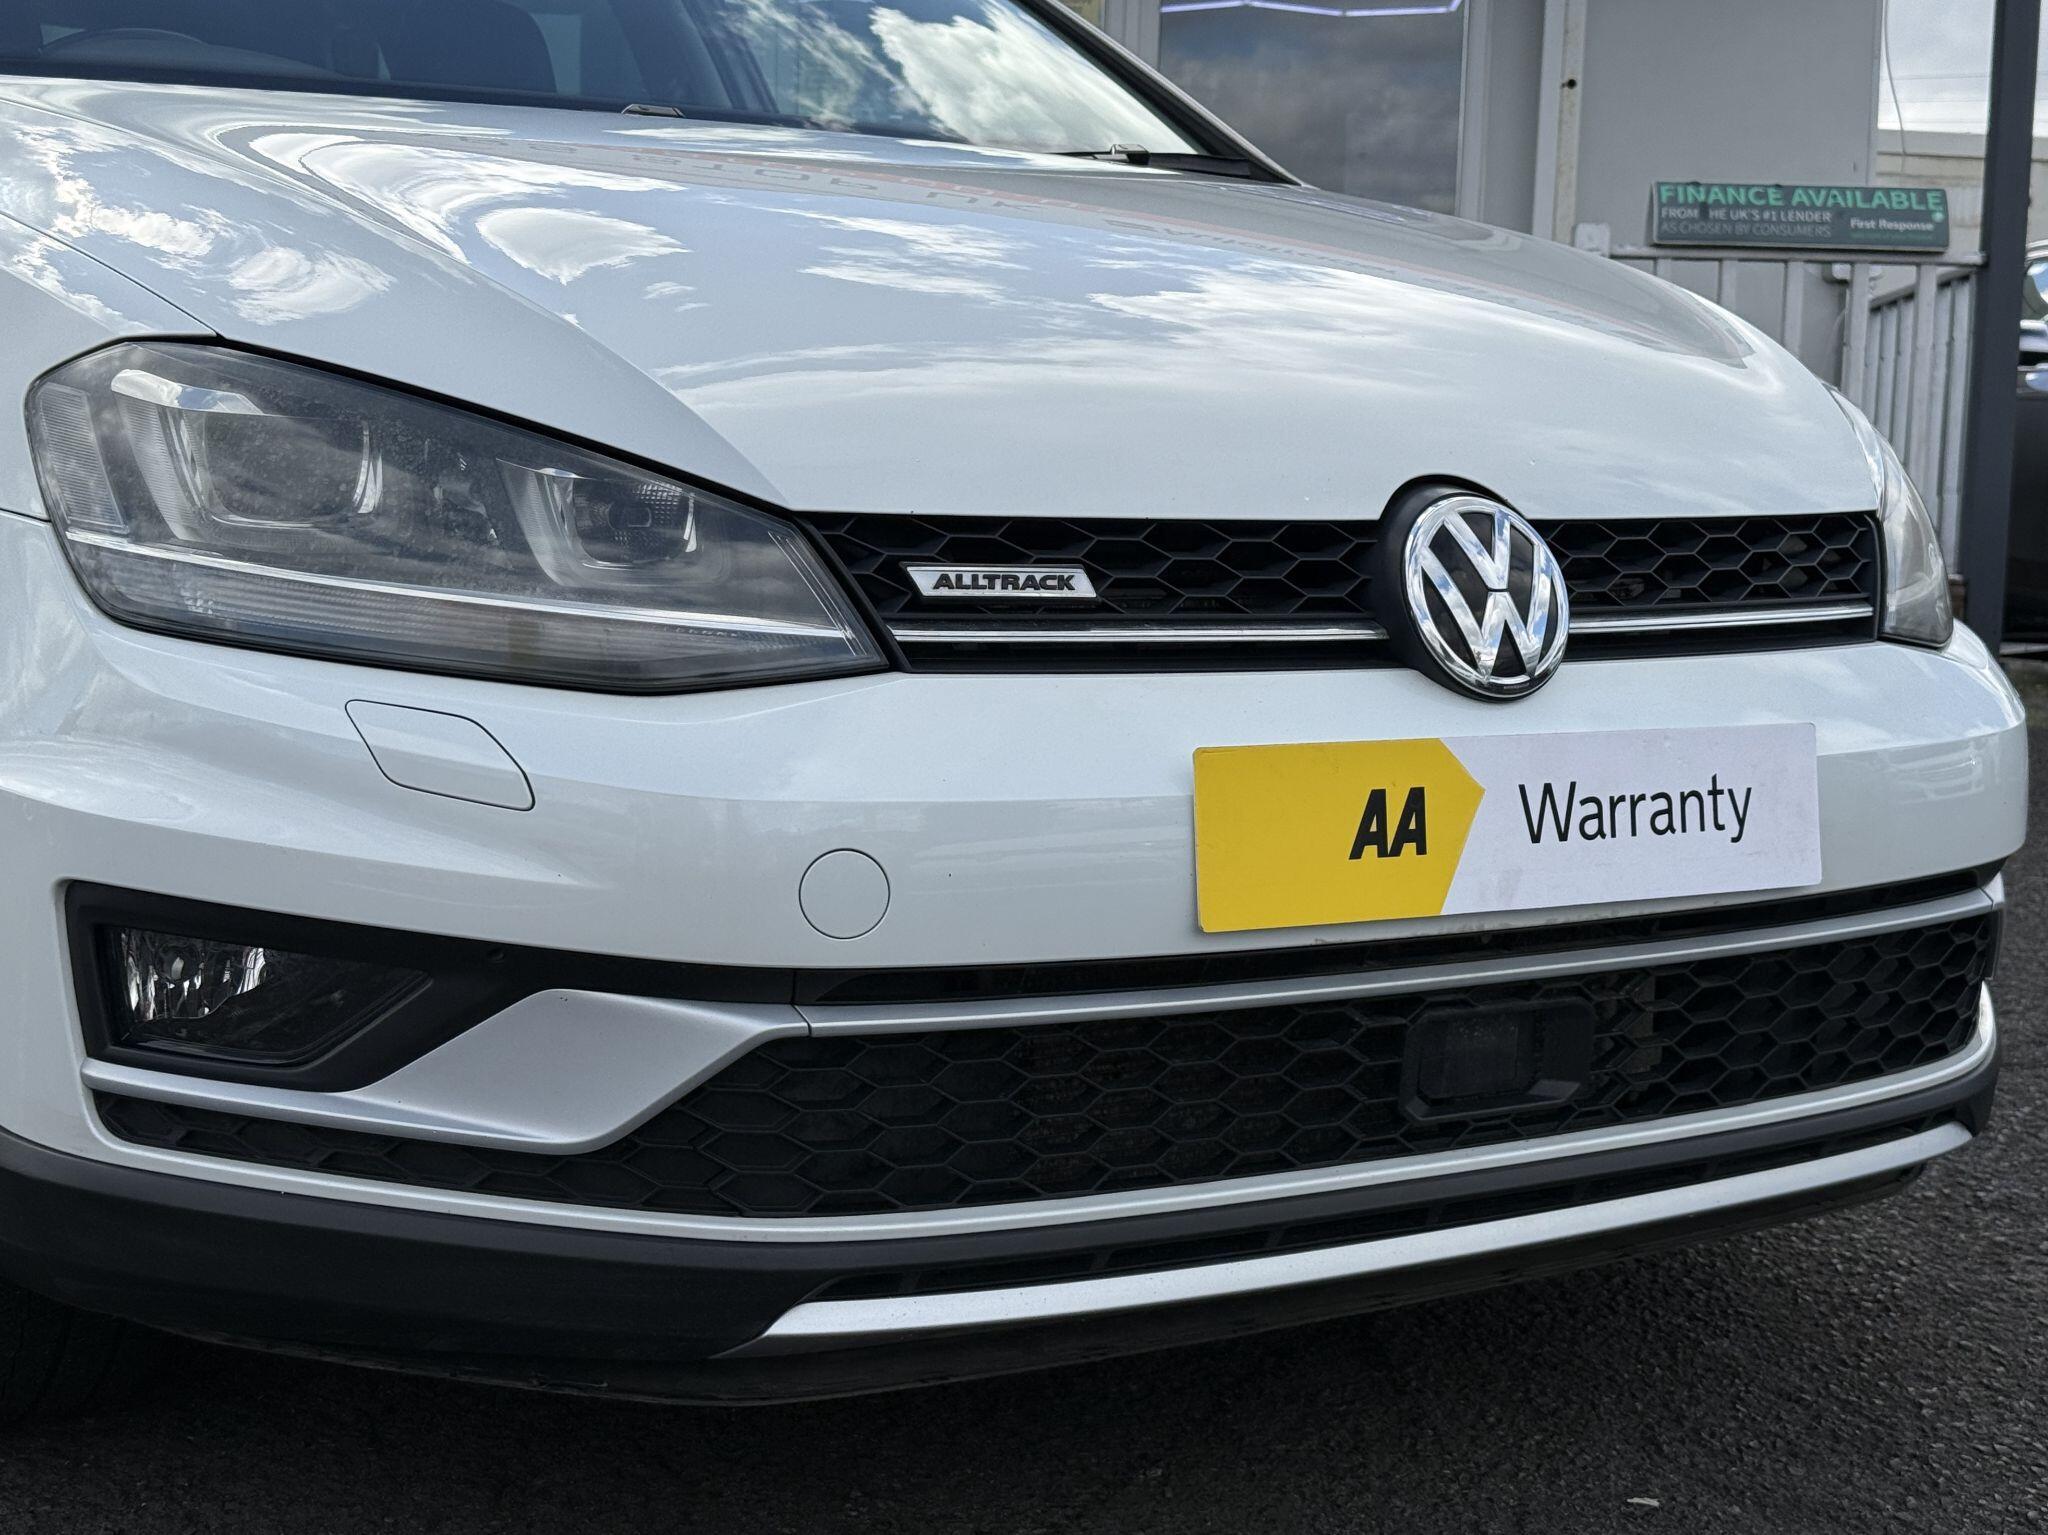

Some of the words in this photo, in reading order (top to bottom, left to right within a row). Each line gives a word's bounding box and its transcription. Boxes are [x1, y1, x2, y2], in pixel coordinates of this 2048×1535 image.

[1660, 184, 1784, 206] FINANCE
[1791, 188, 1945, 211] AVAILABLE
[1661, 207, 1698, 219] FROM
[1700, 207, 1727, 220] HE
[1729, 208, 1760, 221] UK'S
[1780, 210, 1832, 223] LENDER
[1679, 221, 1732, 235] CHOSEN
[1751, 223, 1832, 239] CONSUMERS
[1850, 217, 1876, 230] First
[1879, 218, 1935, 233] Response
[932, 572, 1076, 591] ALLTRACK
[1349, 786, 1428, 861] AA
[1518, 773, 1752, 844] Warranty
